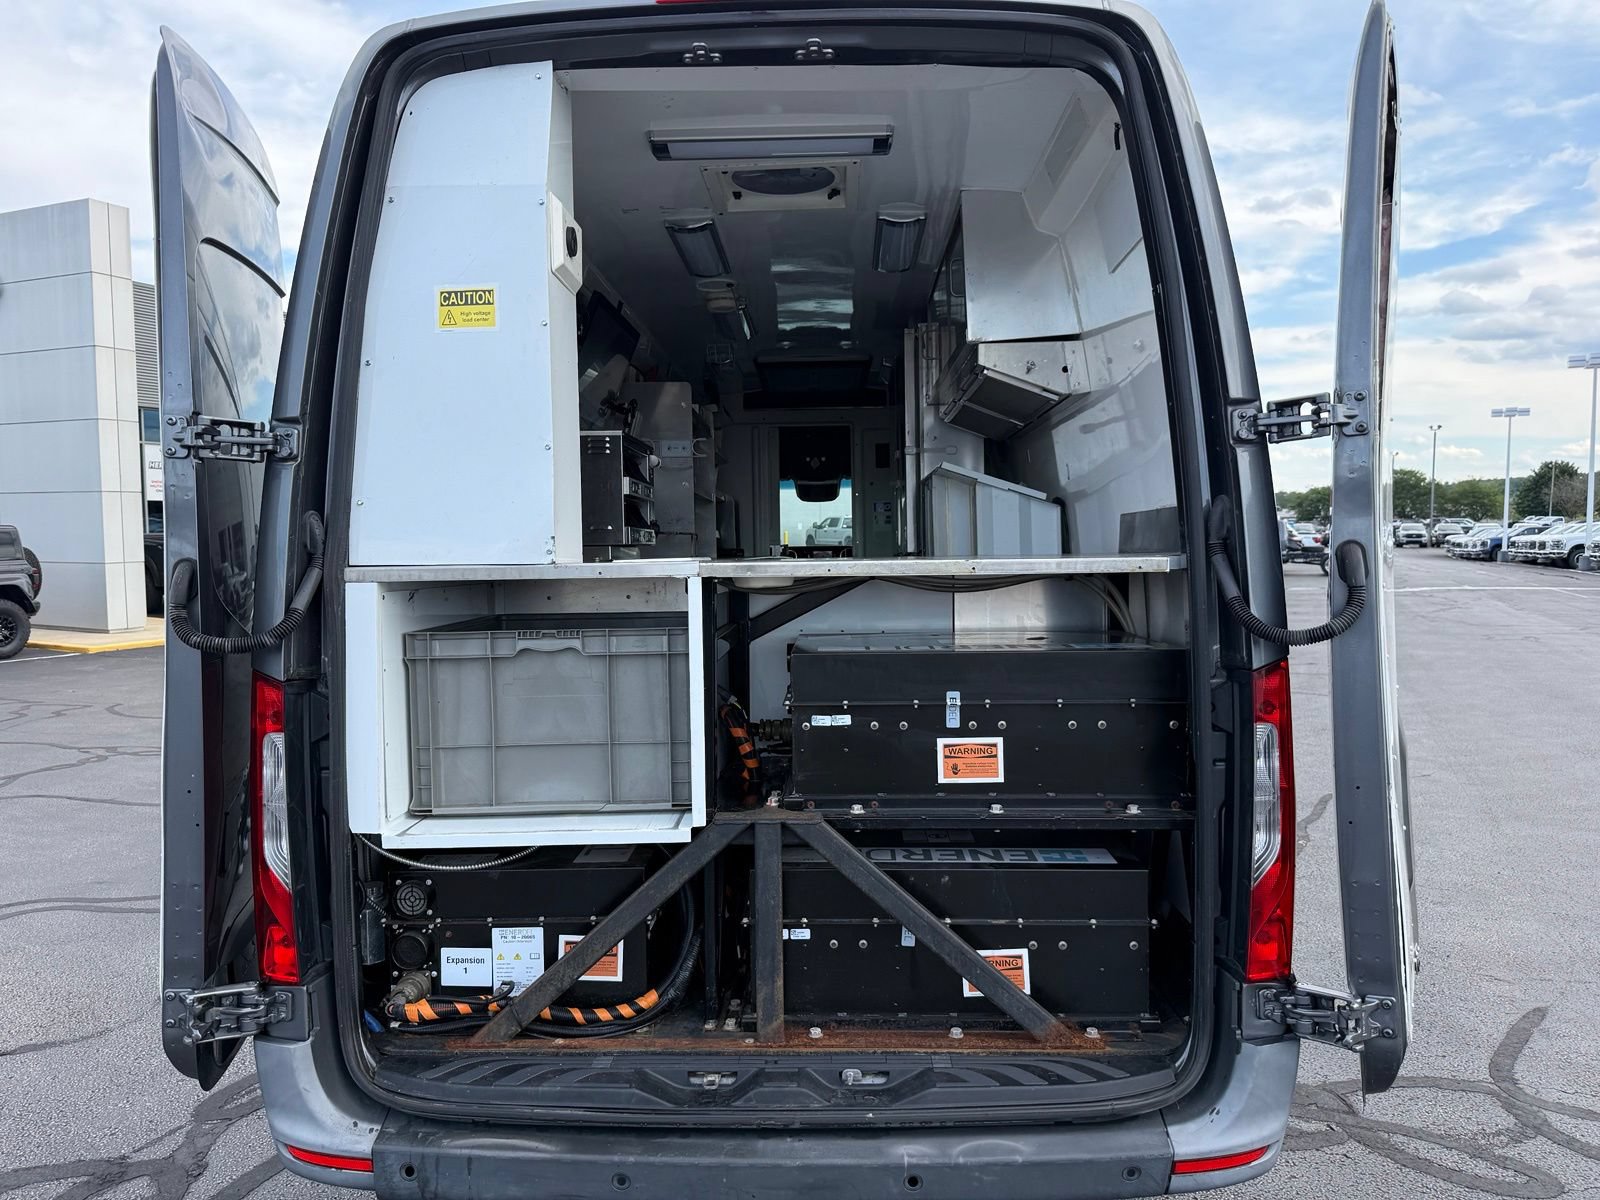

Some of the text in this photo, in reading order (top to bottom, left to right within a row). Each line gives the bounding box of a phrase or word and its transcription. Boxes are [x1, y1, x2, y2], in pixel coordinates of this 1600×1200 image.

[441, 291, 493, 306] CAUTION
[948, 747, 993, 755] WARNING
[862, 848, 1040, 862] ENERD
[446, 955, 485, 966] Expansion
[987, 959, 1019, 968] RNING
[463, 967, 468, 975] 1
